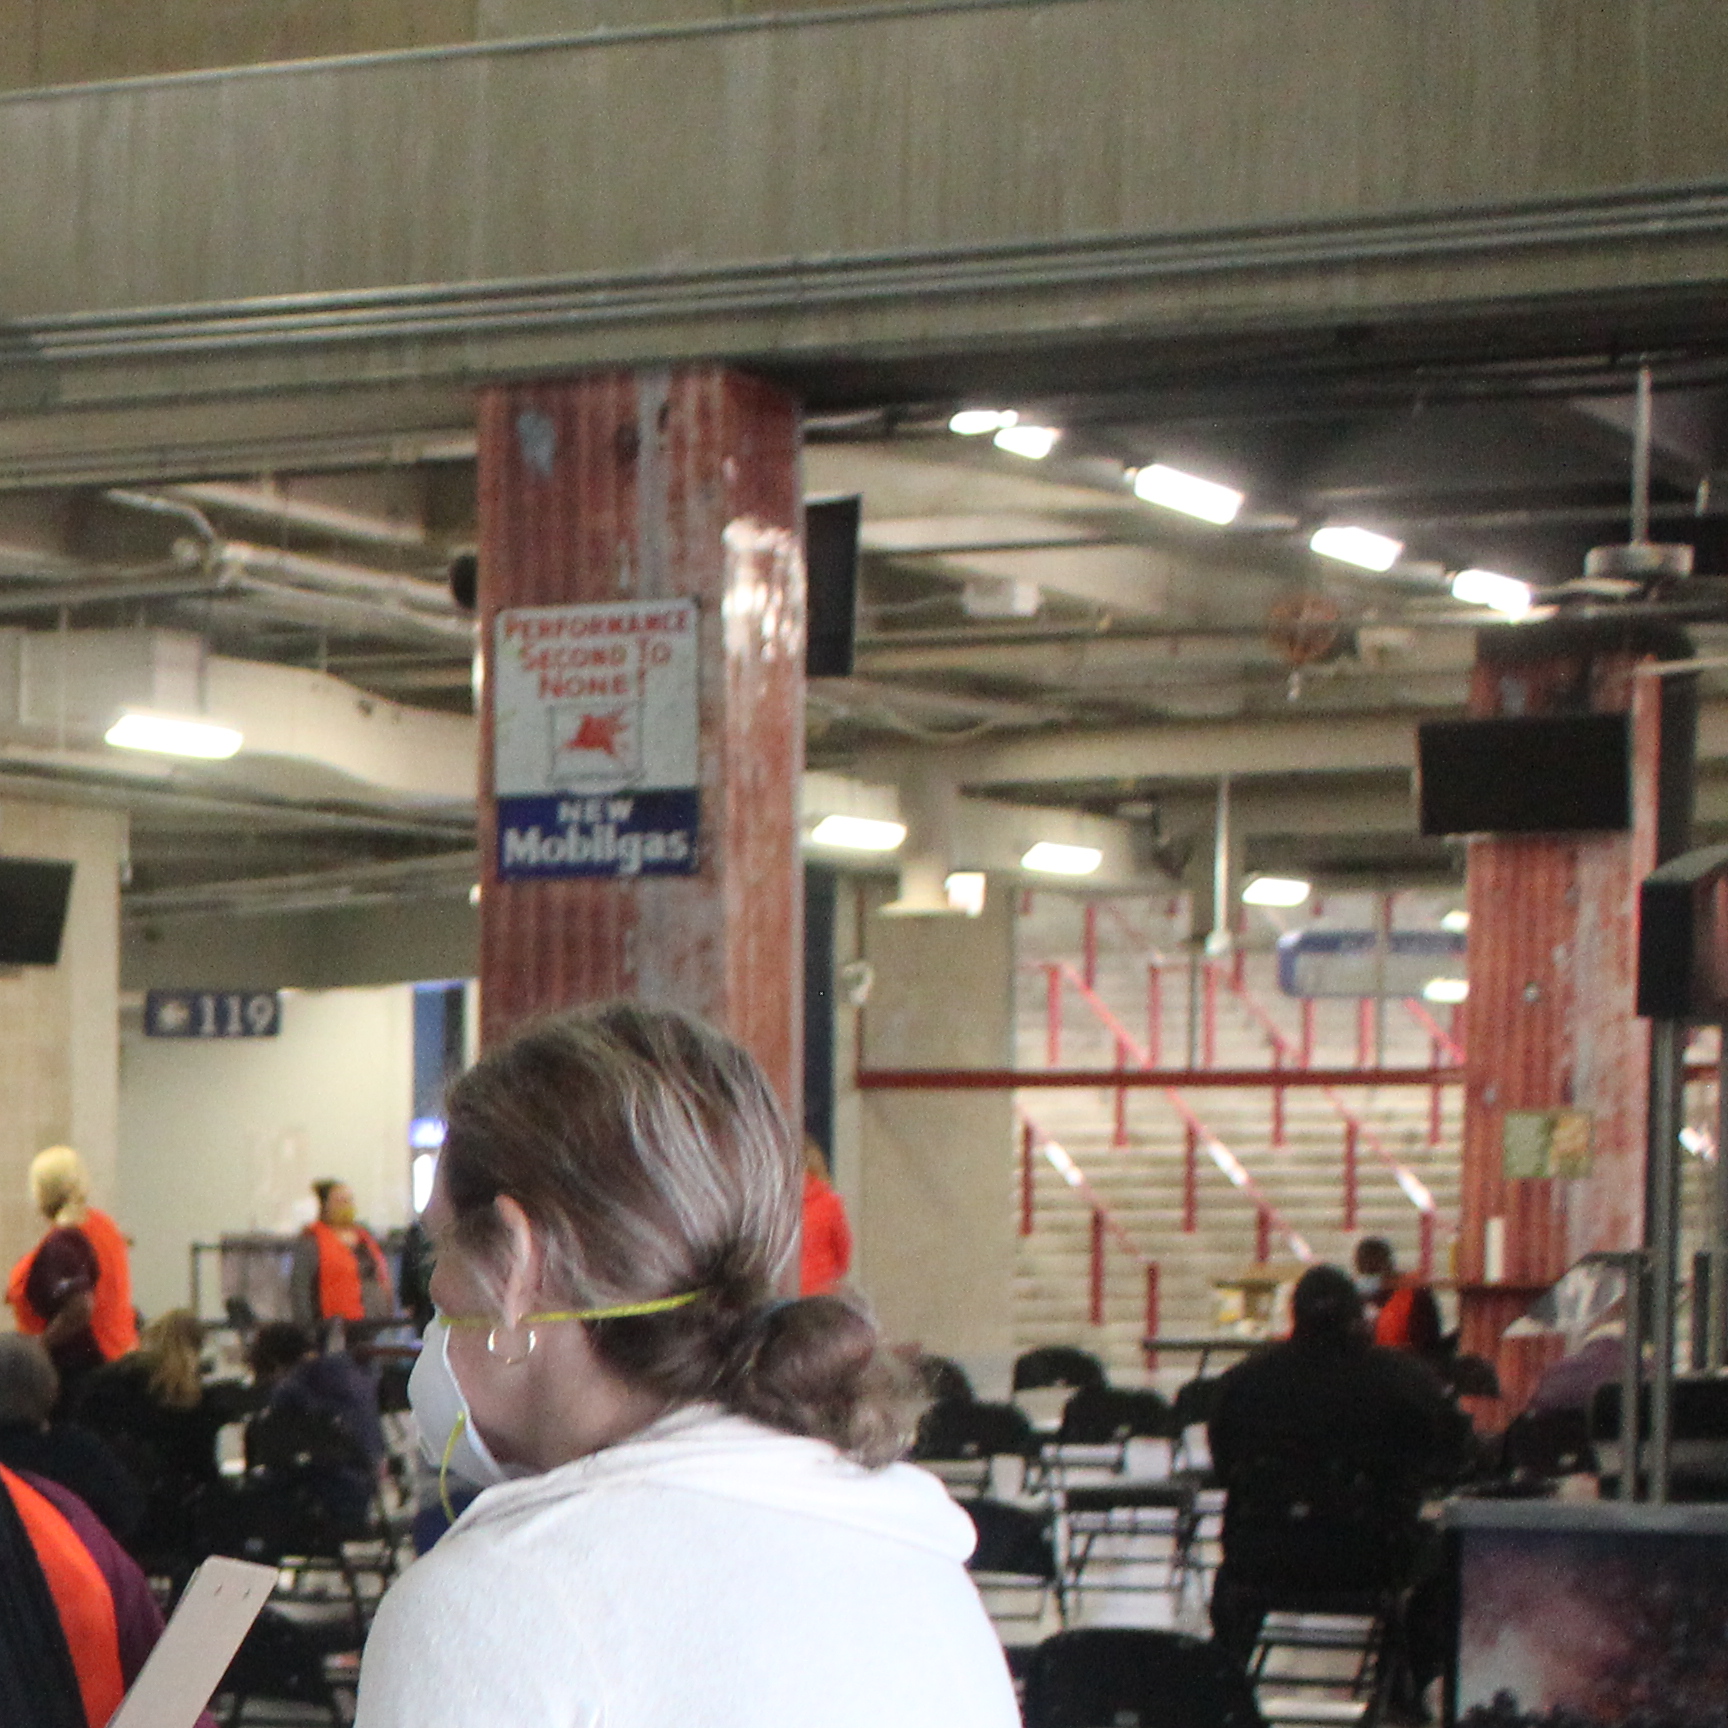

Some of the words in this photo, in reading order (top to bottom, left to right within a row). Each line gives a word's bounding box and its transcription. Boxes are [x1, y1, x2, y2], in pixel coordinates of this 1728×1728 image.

[504, 609, 691, 638] PERFORMANCE
[519, 640, 627, 671] SECOND
[635, 634, 673, 667] TO
[557, 799, 634, 823] NEW
[503, 823, 690, 876] Mobilgas
[200, 995, 275, 1035] 119
